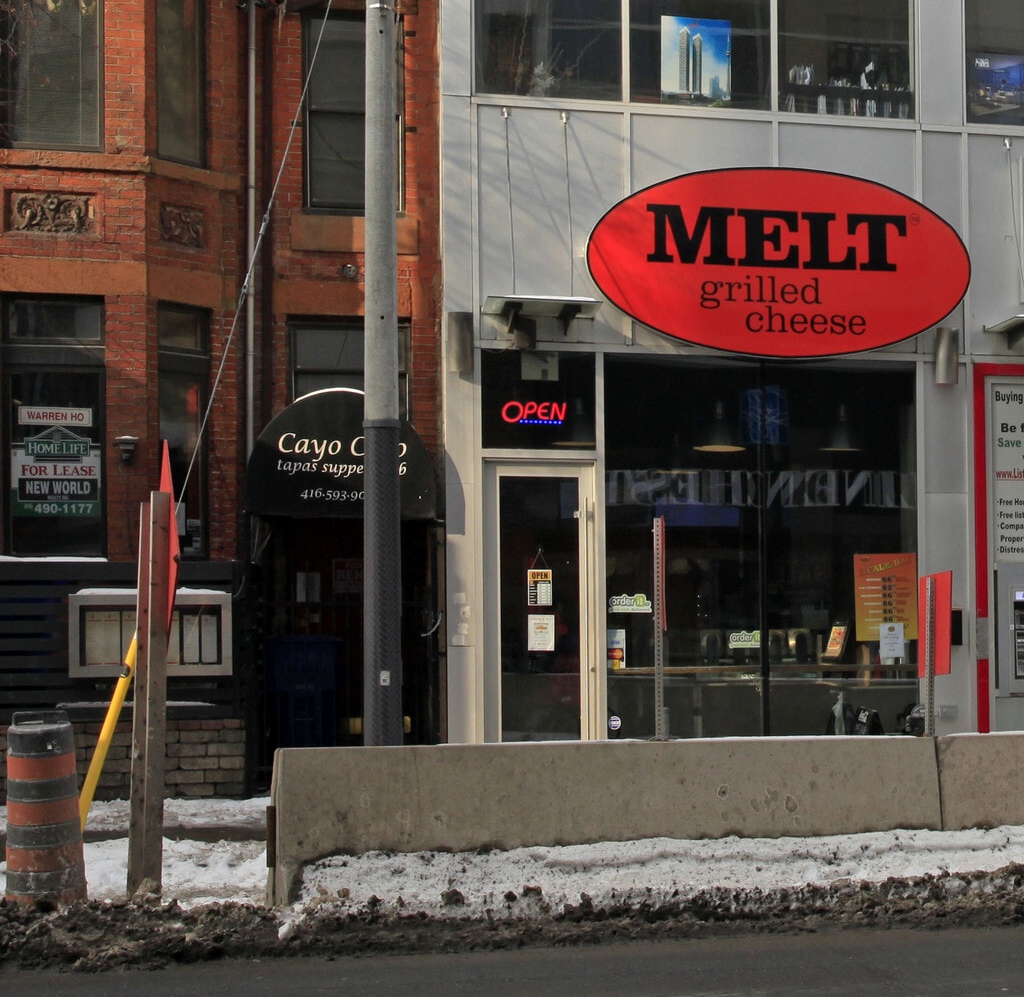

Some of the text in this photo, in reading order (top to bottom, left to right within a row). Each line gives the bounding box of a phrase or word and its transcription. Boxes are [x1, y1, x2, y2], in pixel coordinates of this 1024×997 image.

[646, 203, 907, 272] MELT
[700, 275, 822, 310] grilled
[745, 305, 867, 336] cheese
[995, 390, 1023, 405] Buying
[27, 411, 85, 422] WARREN HO
[500, 400, 567, 423] OPEN
[1000, 422, 1017, 433] Be
[278, 432, 342, 462] Cayo
[997, 437, 1022, 448] Save
[21, 464, 96, 477] FOR LEASE
[277, 458, 365, 478] tapas suppe
[25, 480, 91, 495] NEW WORLD
[999, 498, 1013, 506] Free
[34, 503, 93, 514] 490-1177
[999, 511, 1014, 519] Free
[1014, 511, 1024, 519] list
[531, 571, 549, 580] OPEN
[611, 595, 645, 606] order it
[731, 633, 753, 642] order
